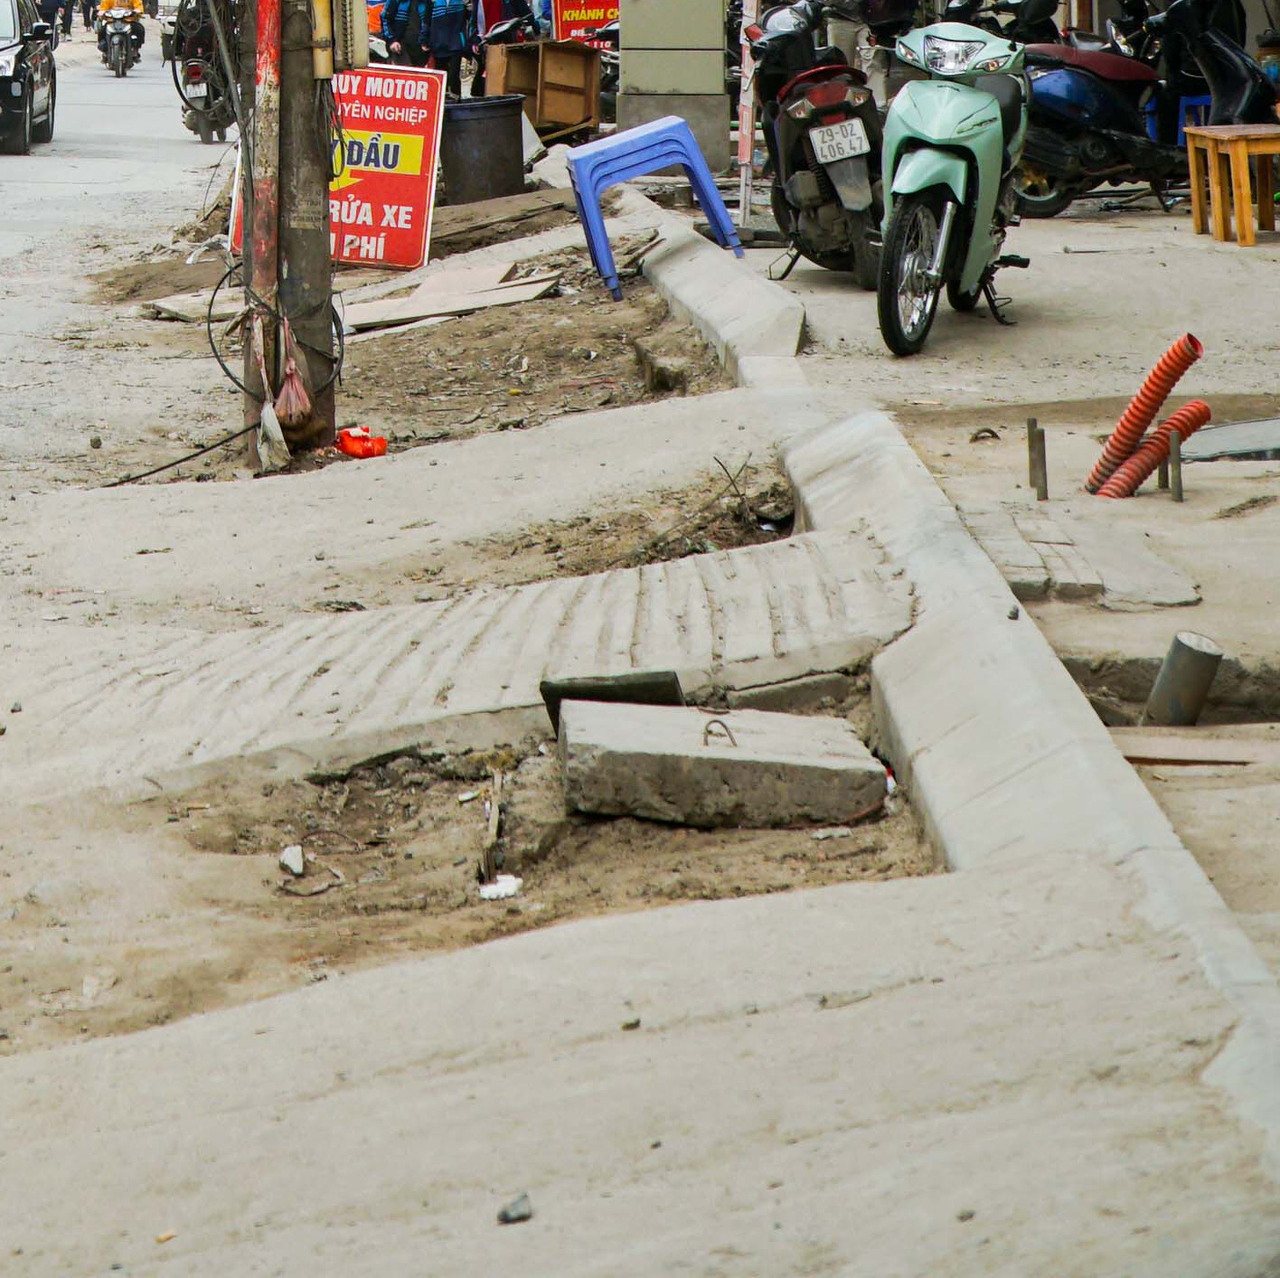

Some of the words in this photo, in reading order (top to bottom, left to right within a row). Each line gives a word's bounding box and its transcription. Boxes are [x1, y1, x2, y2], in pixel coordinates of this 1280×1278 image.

[365, 77, 429, 101] MOTOR
[374, 106, 428, 125] NGHIỆP
[347, 134, 400, 169] DẦU
[821, 136, 863, 160] 406.47
[330, 194, 373, 227] RỬA
[380, 204, 413, 229] XE
[342, 232, 387, 260] PHÍ
